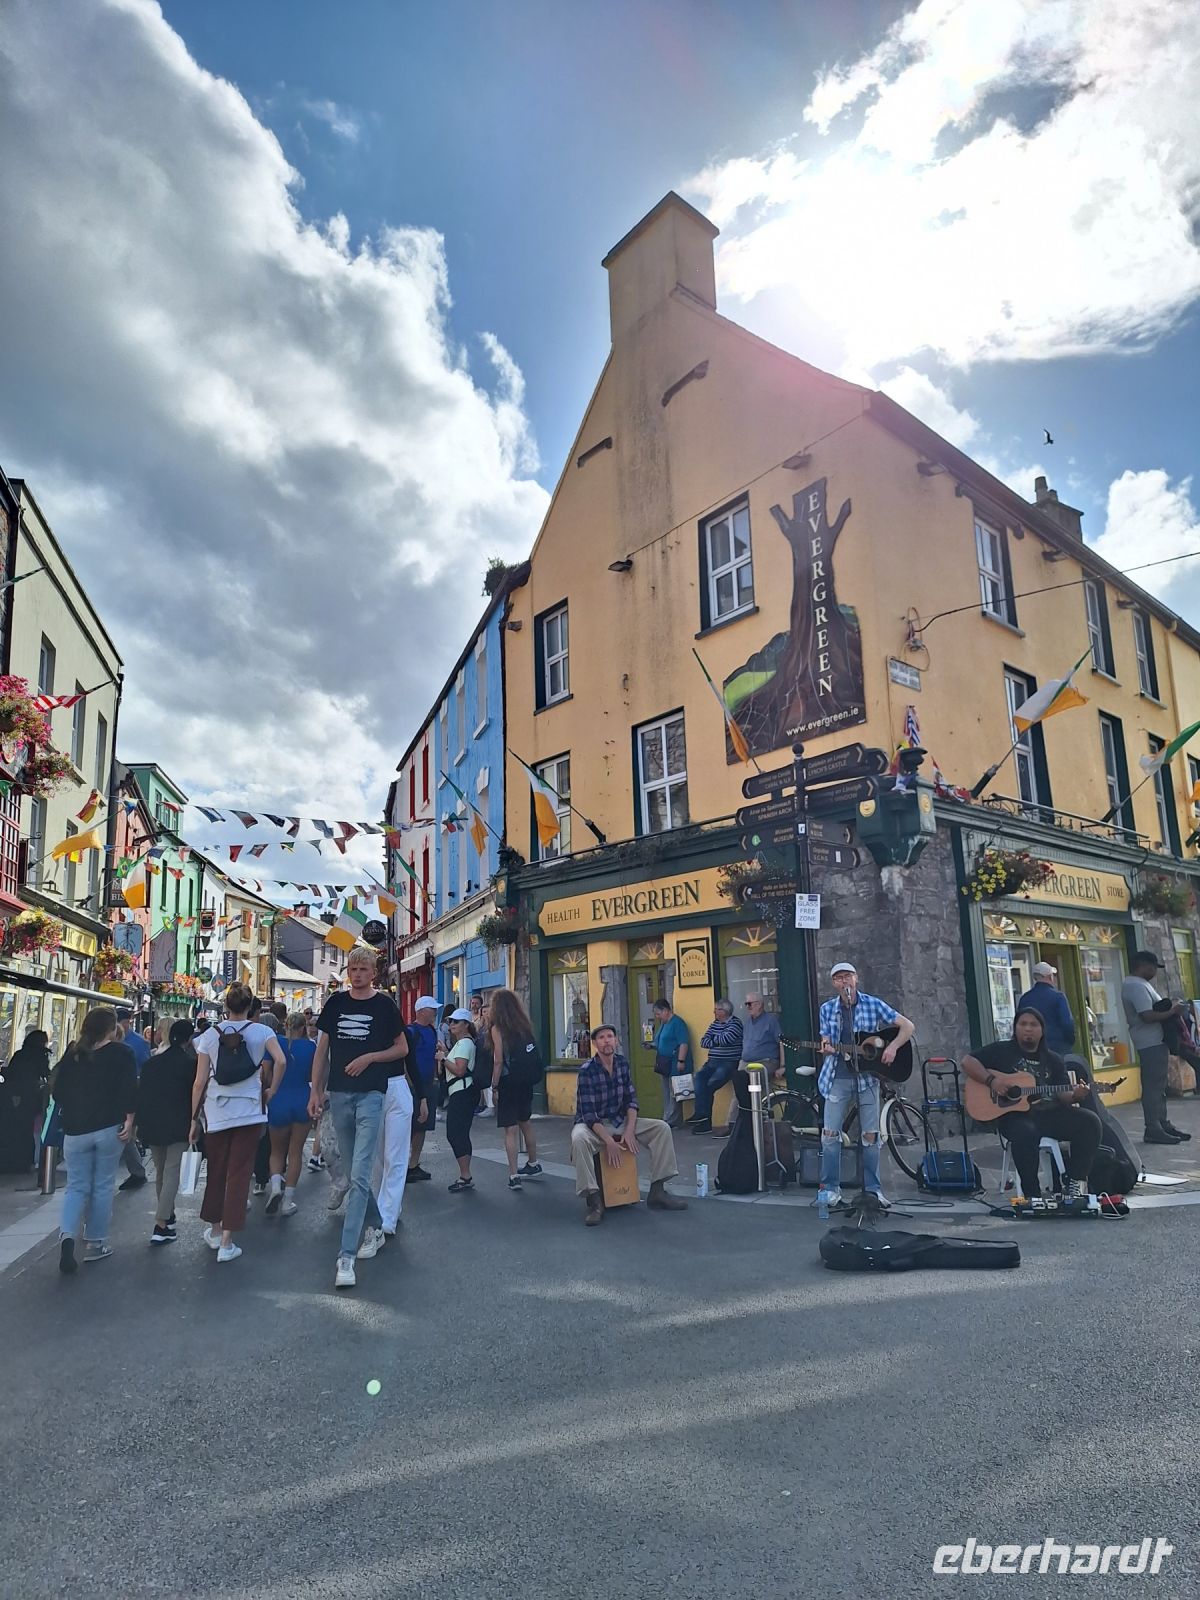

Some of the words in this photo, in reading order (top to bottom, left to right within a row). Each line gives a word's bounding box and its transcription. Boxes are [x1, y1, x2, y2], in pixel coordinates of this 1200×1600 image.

[808, 491, 832, 697] EVERGREEN
[786, 705, 859, 736] www.evergreen.ie
[828, 760, 847, 770] CASTLE
[778, 806, 793, 815] ARCH
[773, 833, 795, 843] MUSEUM
[1028, 872, 1102, 902] ERGREEN
[1106, 886, 1124, 898] STORE
[547, 908, 580, 924] HEALTH
[592, 880, 700, 920] EVERGREEN
[682, 969, 706, 978] CORNER
